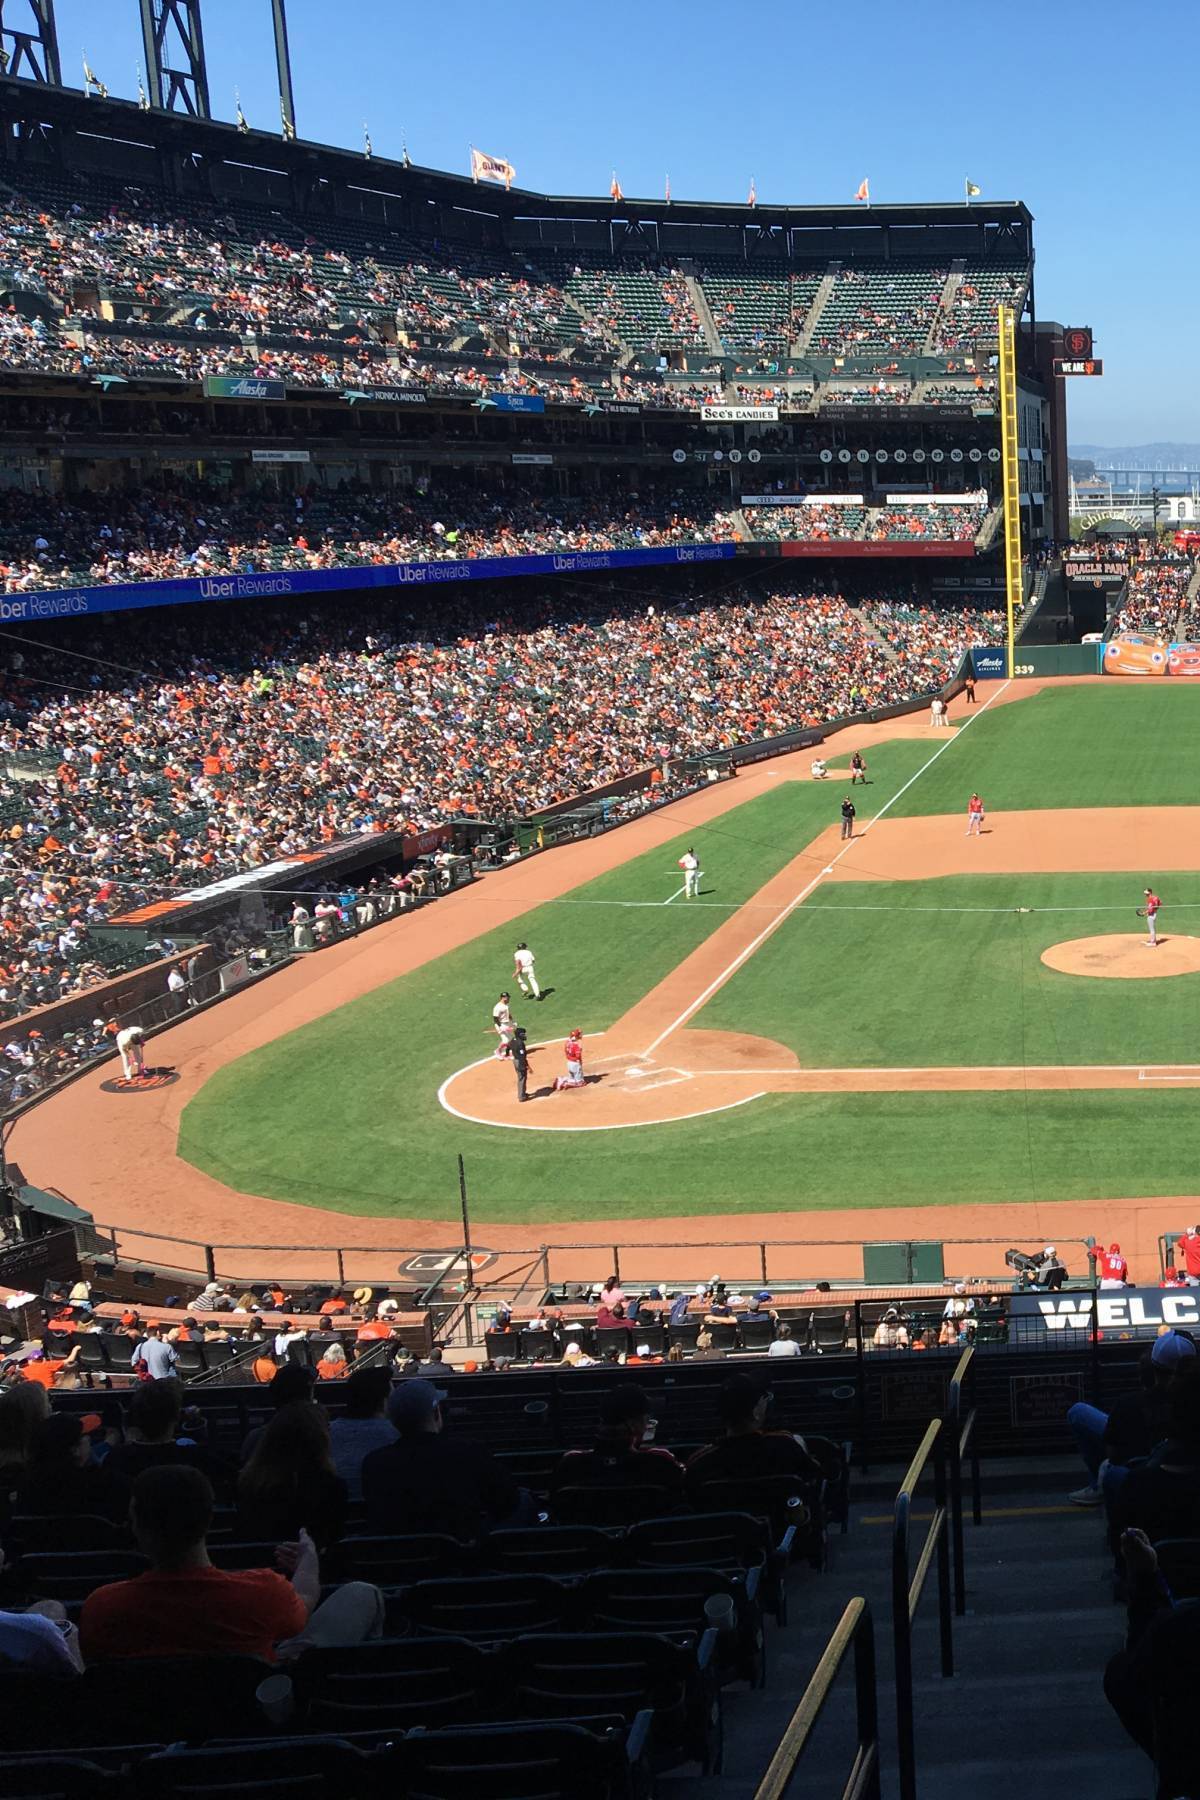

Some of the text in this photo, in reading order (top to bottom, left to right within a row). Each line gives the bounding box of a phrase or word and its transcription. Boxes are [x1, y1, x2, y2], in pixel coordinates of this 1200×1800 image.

[1062, 362, 1085, 372] WE ARE
[230, 379, 267, 397] Alaska
[374, 391, 426, 403] KONICA MINOLTA
[704, 408, 774, 419] See's CANDIES
[1080, 509, 1144, 530] Ghirardelli
[677, 547, 723, 561] Uber Rewards
[553, 553, 611, 570] Uber Rewards
[398, 563, 471, 582] Uber Rewards
[1066, 563, 1129, 576] ORACLE PARK
[200, 575, 292, 598] Uber Rewards
[0, 593, 88, 619] ber Rewards
[977, 658, 1003, 667] Alaska
[1015, 665, 1034, 674] 339
